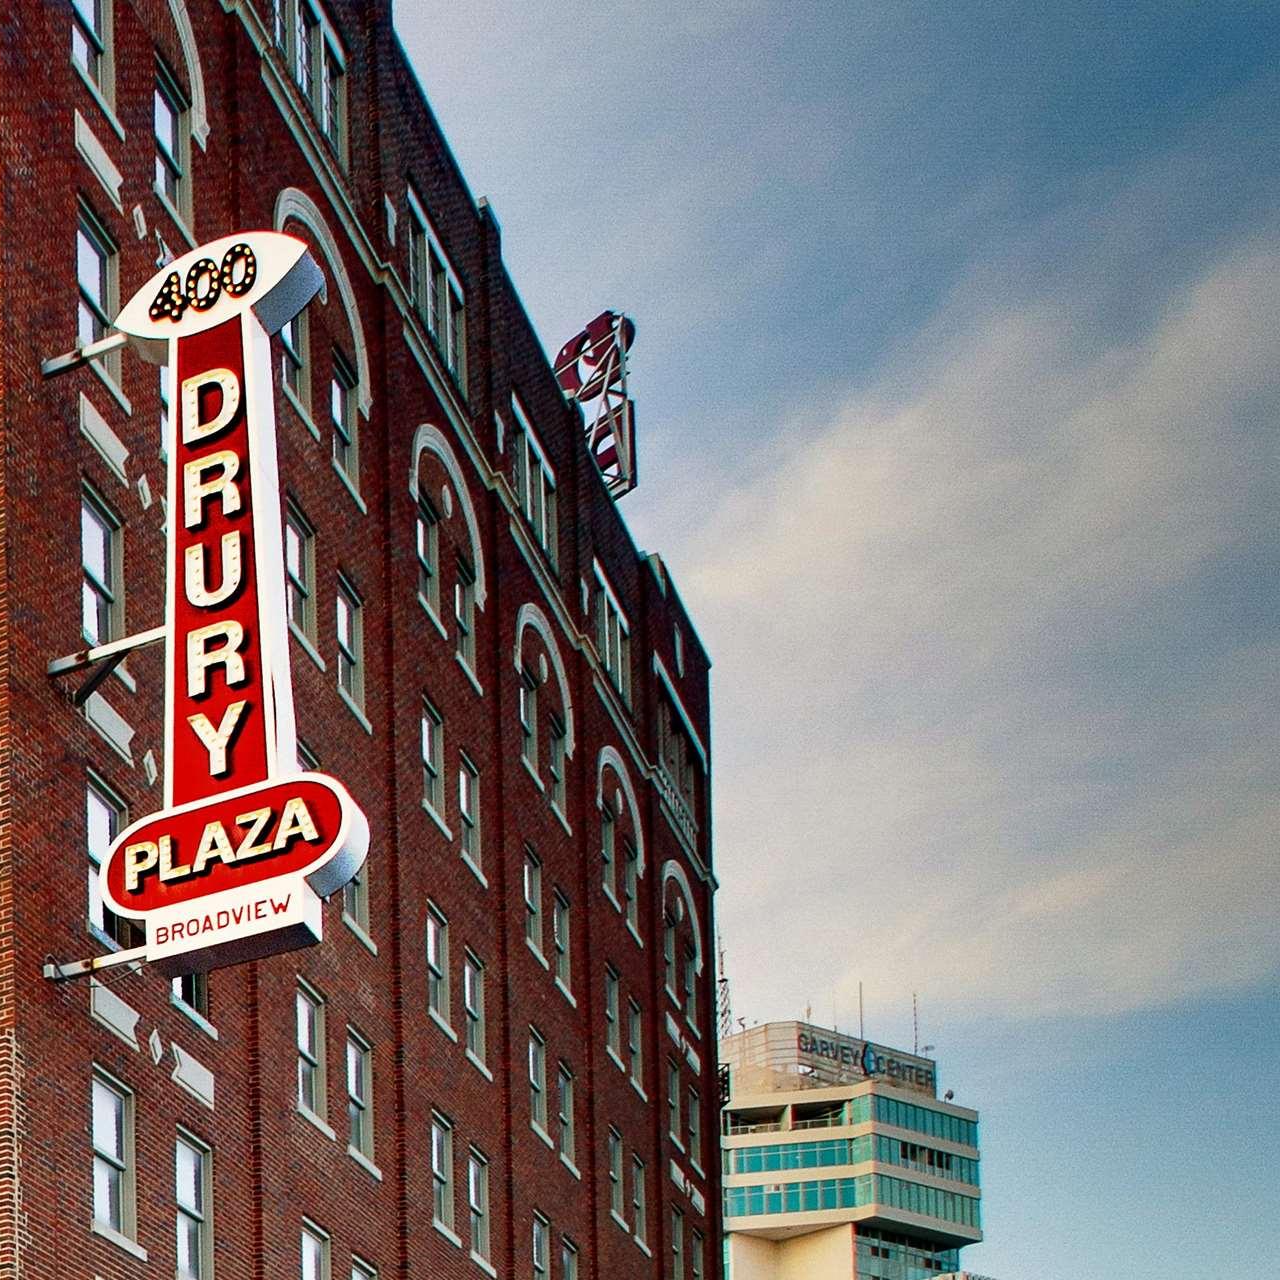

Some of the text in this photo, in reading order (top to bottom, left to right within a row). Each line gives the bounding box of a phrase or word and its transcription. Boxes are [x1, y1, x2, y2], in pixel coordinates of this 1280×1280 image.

[148, 242, 258, 324] 400
[180, 366, 248, 777] DRURY
[124, 796, 320, 892] PLAZA
[155, 893, 292, 945] BROADVIEW
[798, 1030, 933, 1087] GARVEY CENTER
